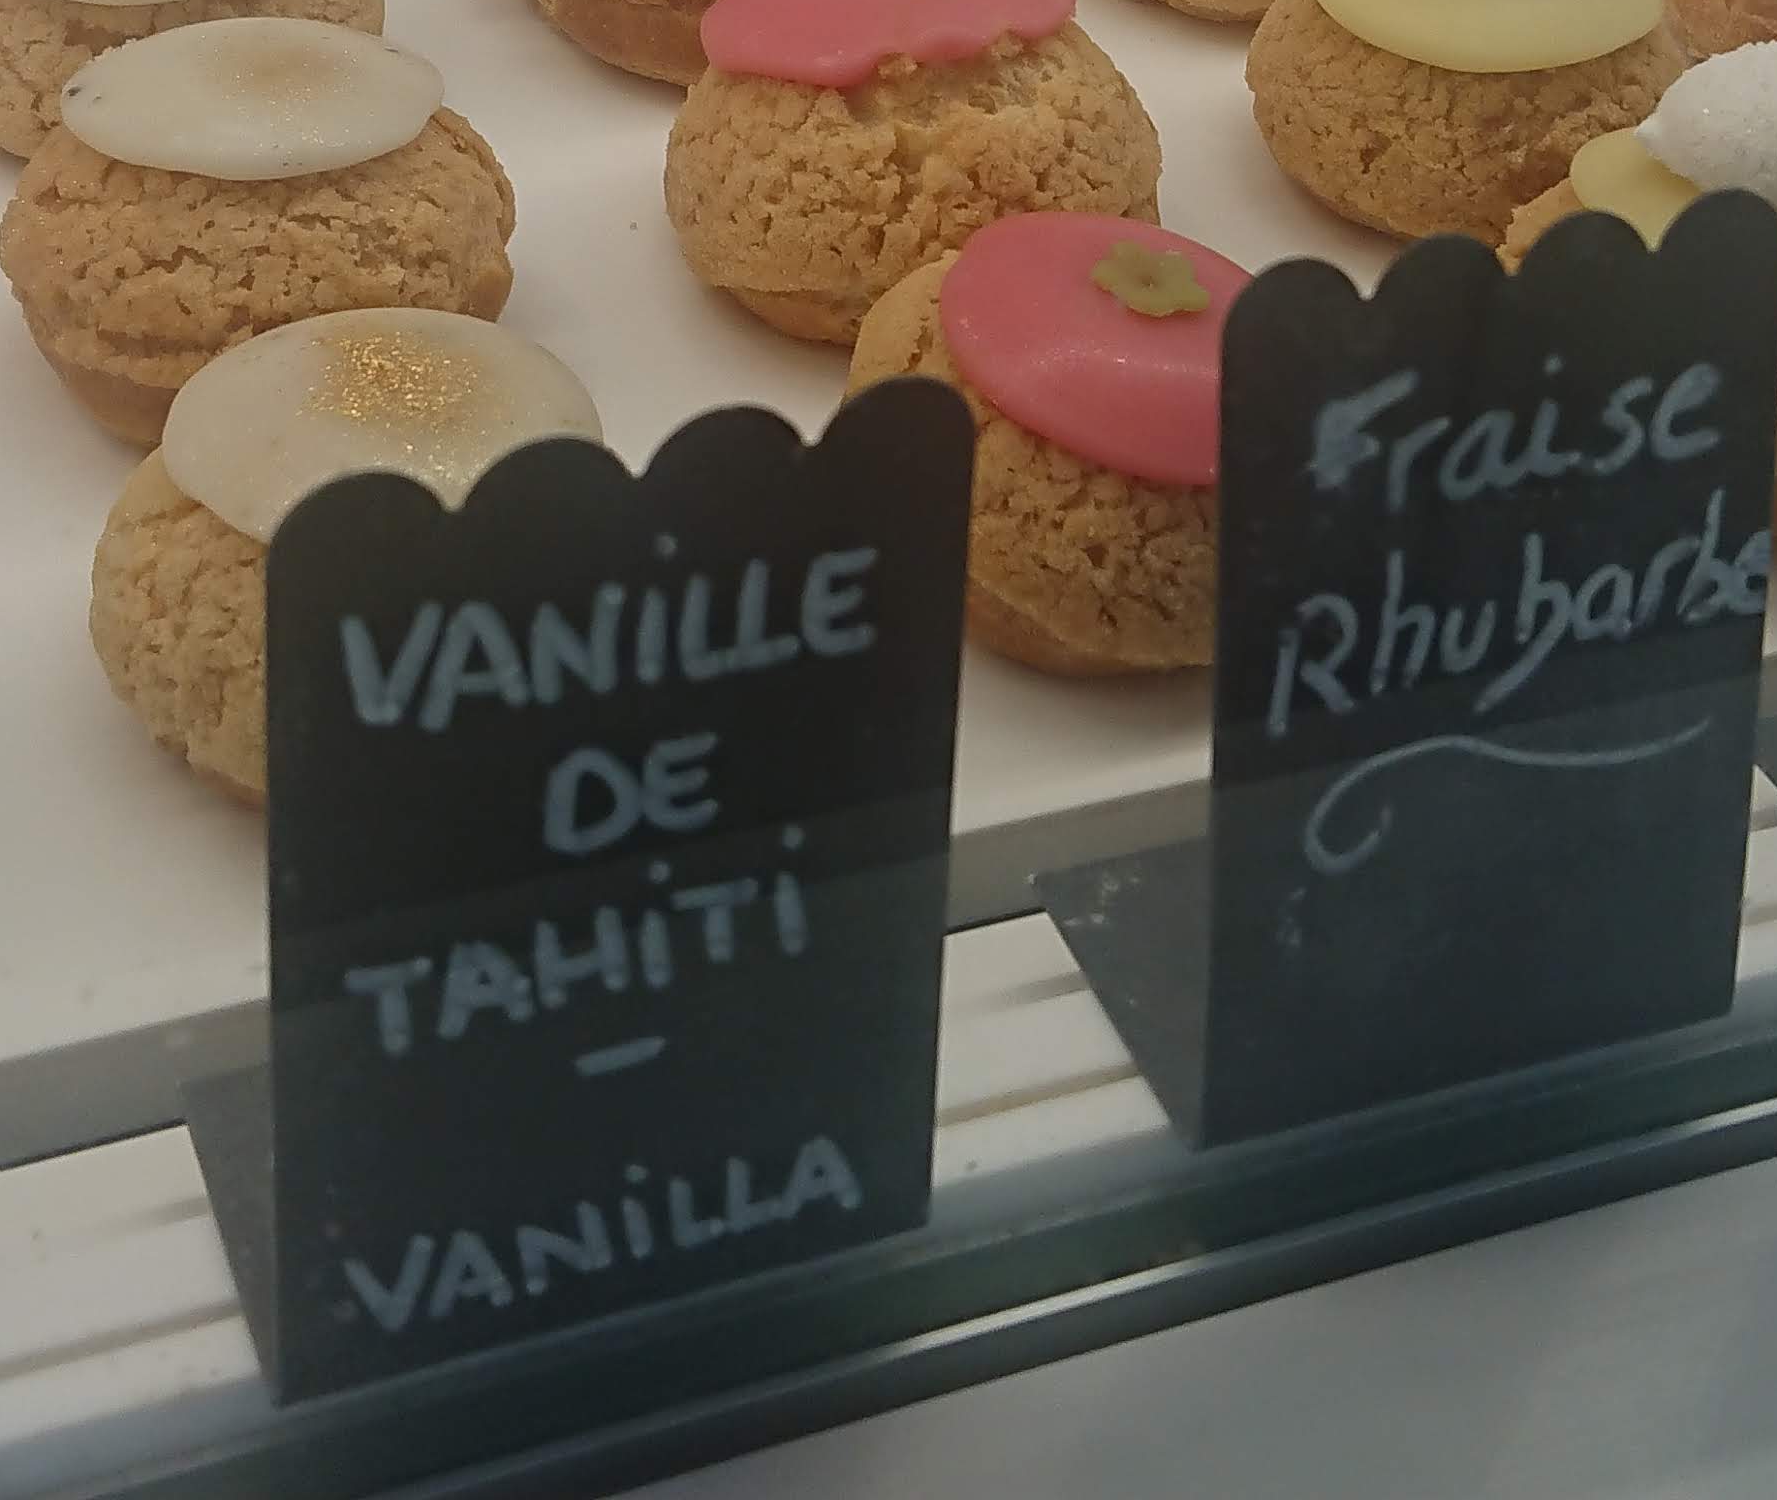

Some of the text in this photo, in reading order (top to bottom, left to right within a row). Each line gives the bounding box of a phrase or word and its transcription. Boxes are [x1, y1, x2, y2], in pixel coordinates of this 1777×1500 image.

[1306, 353, 1724, 512] Fraise
[1266, 487, 1772, 737] Rhubarbe
[543, 733, 719, 854] DE
